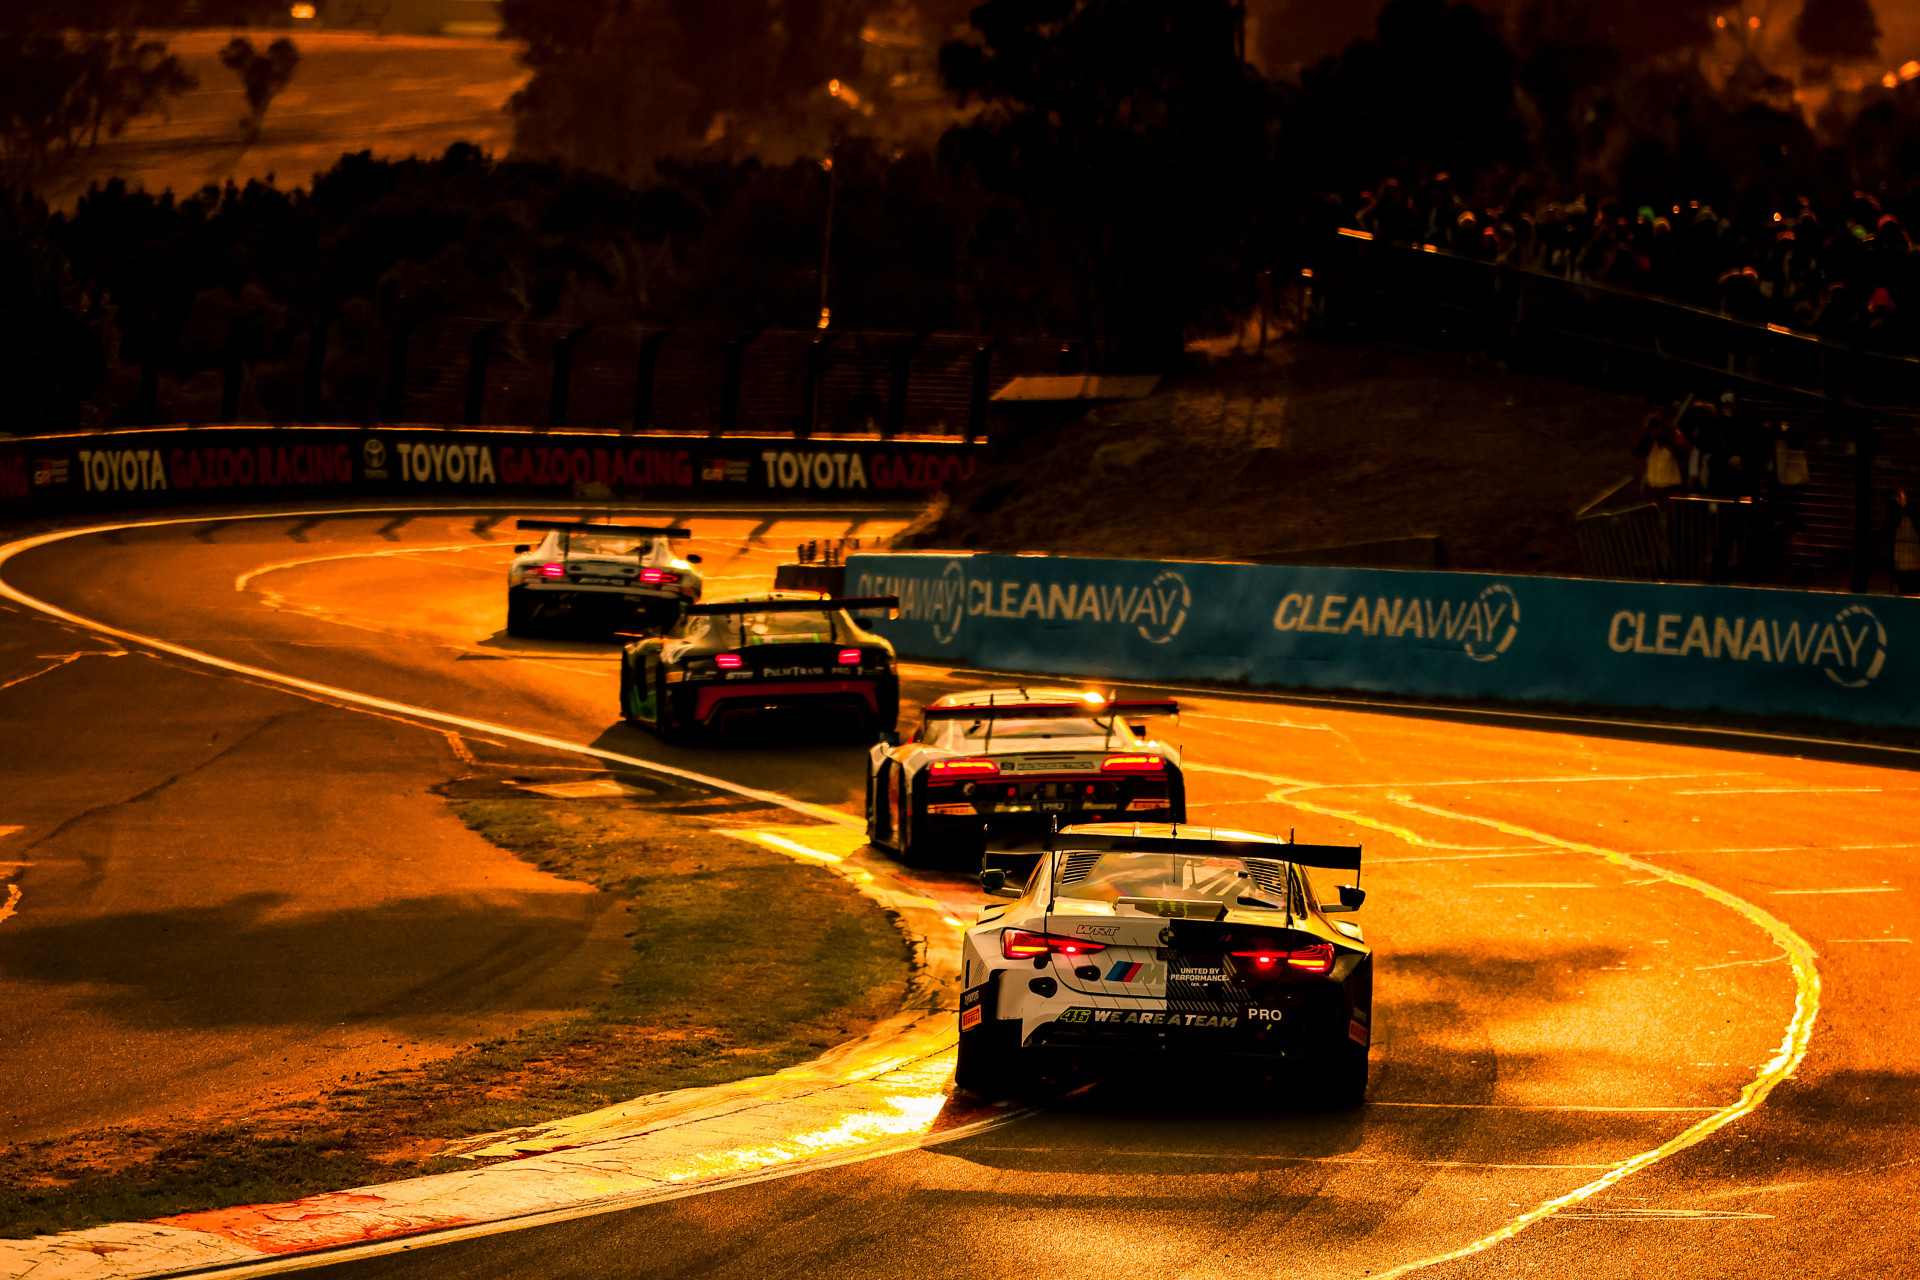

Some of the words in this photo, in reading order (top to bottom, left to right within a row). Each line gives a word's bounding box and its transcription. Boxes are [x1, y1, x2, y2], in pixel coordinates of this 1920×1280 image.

[78, 449, 168, 491] TOYOTA
[170, 446, 255, 488] GAZOO
[257, 443, 353, 487] RACING
[396, 442, 497, 484] TOYOTA
[498, 446, 591, 485] GAZOO
[592, 447, 693, 486] RACING
[761, 452, 868, 489] TOYOTA
[967, 579, 1177, 624] CLEANAWAY
[1273, 592, 1507, 642] CLEANAWAY
[1607, 609, 1869, 668] CLEANAWAY
[1076, 924, 1121, 937] WRT
[1180, 967, 1209, 975] UNITED
[1208, 967, 1220, 975] BY
[1060, 1009, 1091, 1023] 46
[1094, 1010, 1124, 1022] WE
[1124, 1012, 1166, 1025] ARE
[1166, 1014, 1182, 1026] A
[1184, 1014, 1238, 1029] TEAM
[1247, 1008, 1283, 1021] PRO
